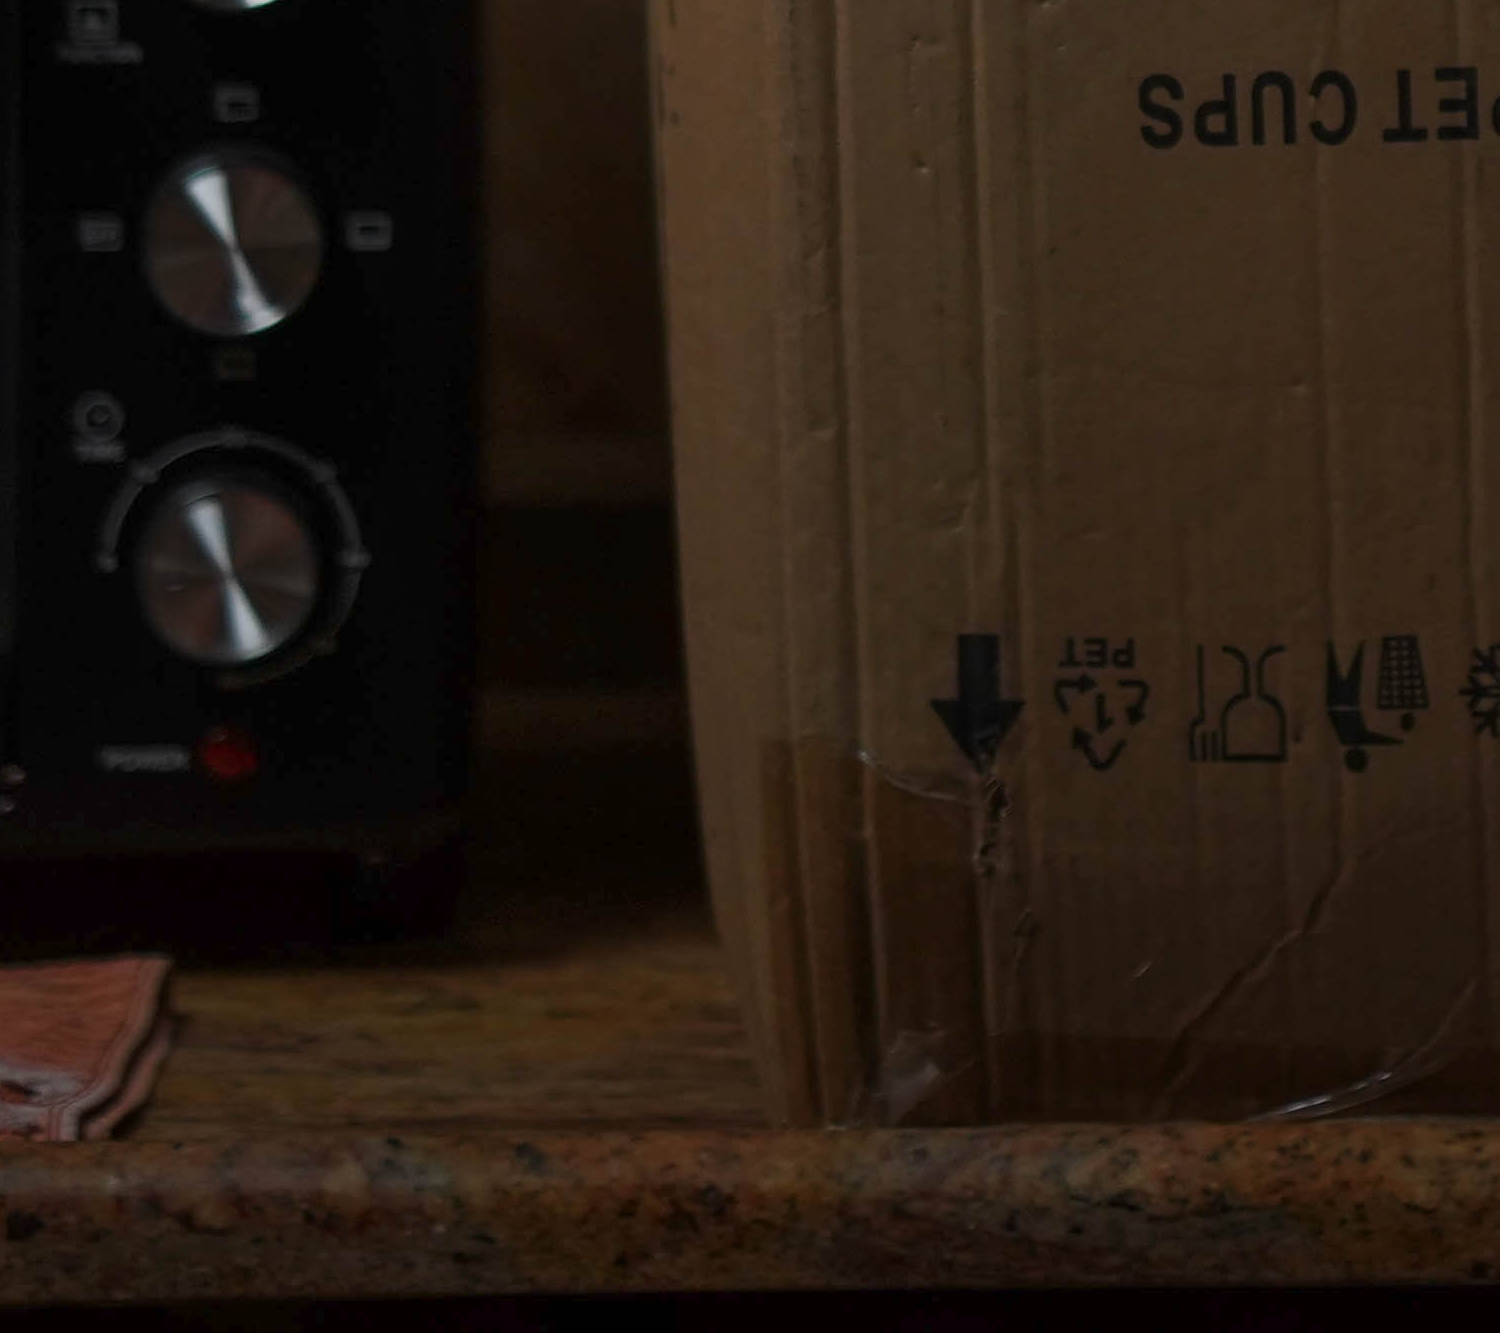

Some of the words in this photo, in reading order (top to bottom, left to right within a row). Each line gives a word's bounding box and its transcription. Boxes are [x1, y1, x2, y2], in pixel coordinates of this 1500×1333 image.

[1137, 70, 1358, 150] CUPS
[1058, 638, 1135, 669] PET
[1096, 694, 1115, 734] 1
